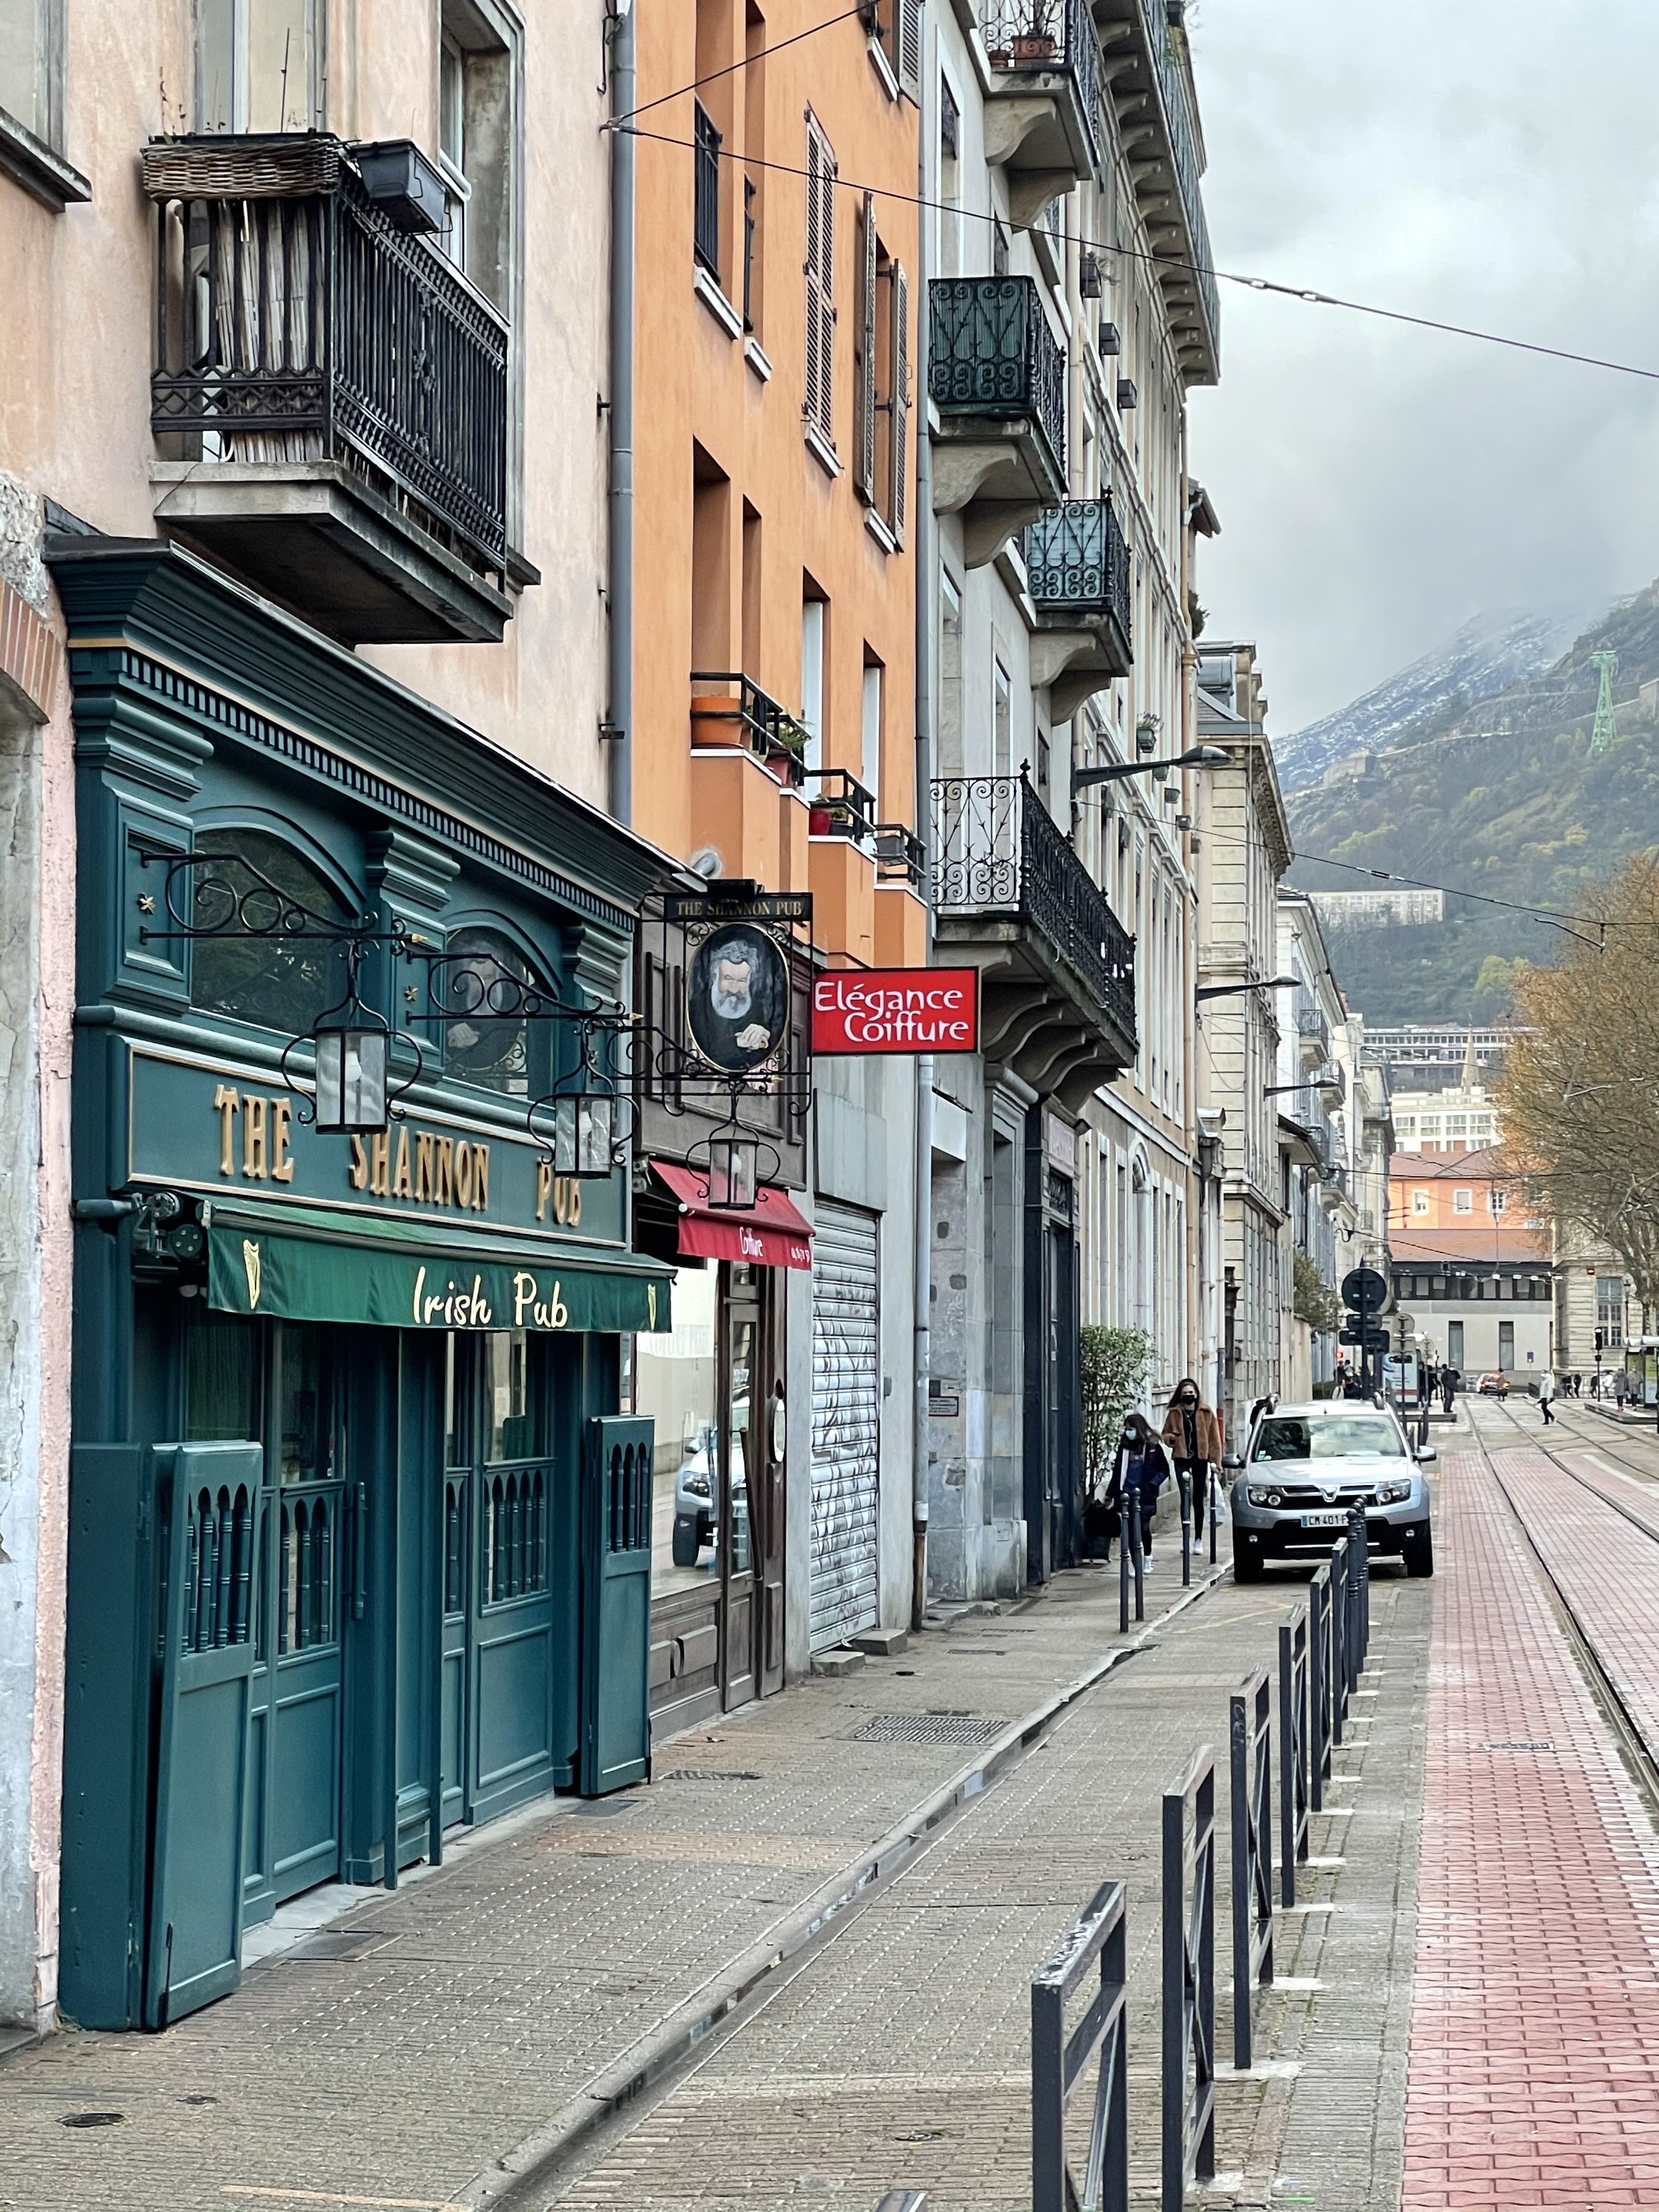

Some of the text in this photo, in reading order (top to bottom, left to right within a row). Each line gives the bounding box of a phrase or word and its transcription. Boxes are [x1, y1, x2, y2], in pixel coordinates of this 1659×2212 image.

[676, 901, 802, 916] THE SHANNON PUB
[815, 980, 963, 1022] Elégance
[844, 1010, 969, 1042] Coiffure
[215, 1084, 582, 1227] THE SHANNON PUB
[413, 1266, 568, 1328] Irish Pub
[1308, 1515, 1347, 1526] CM-401-F
